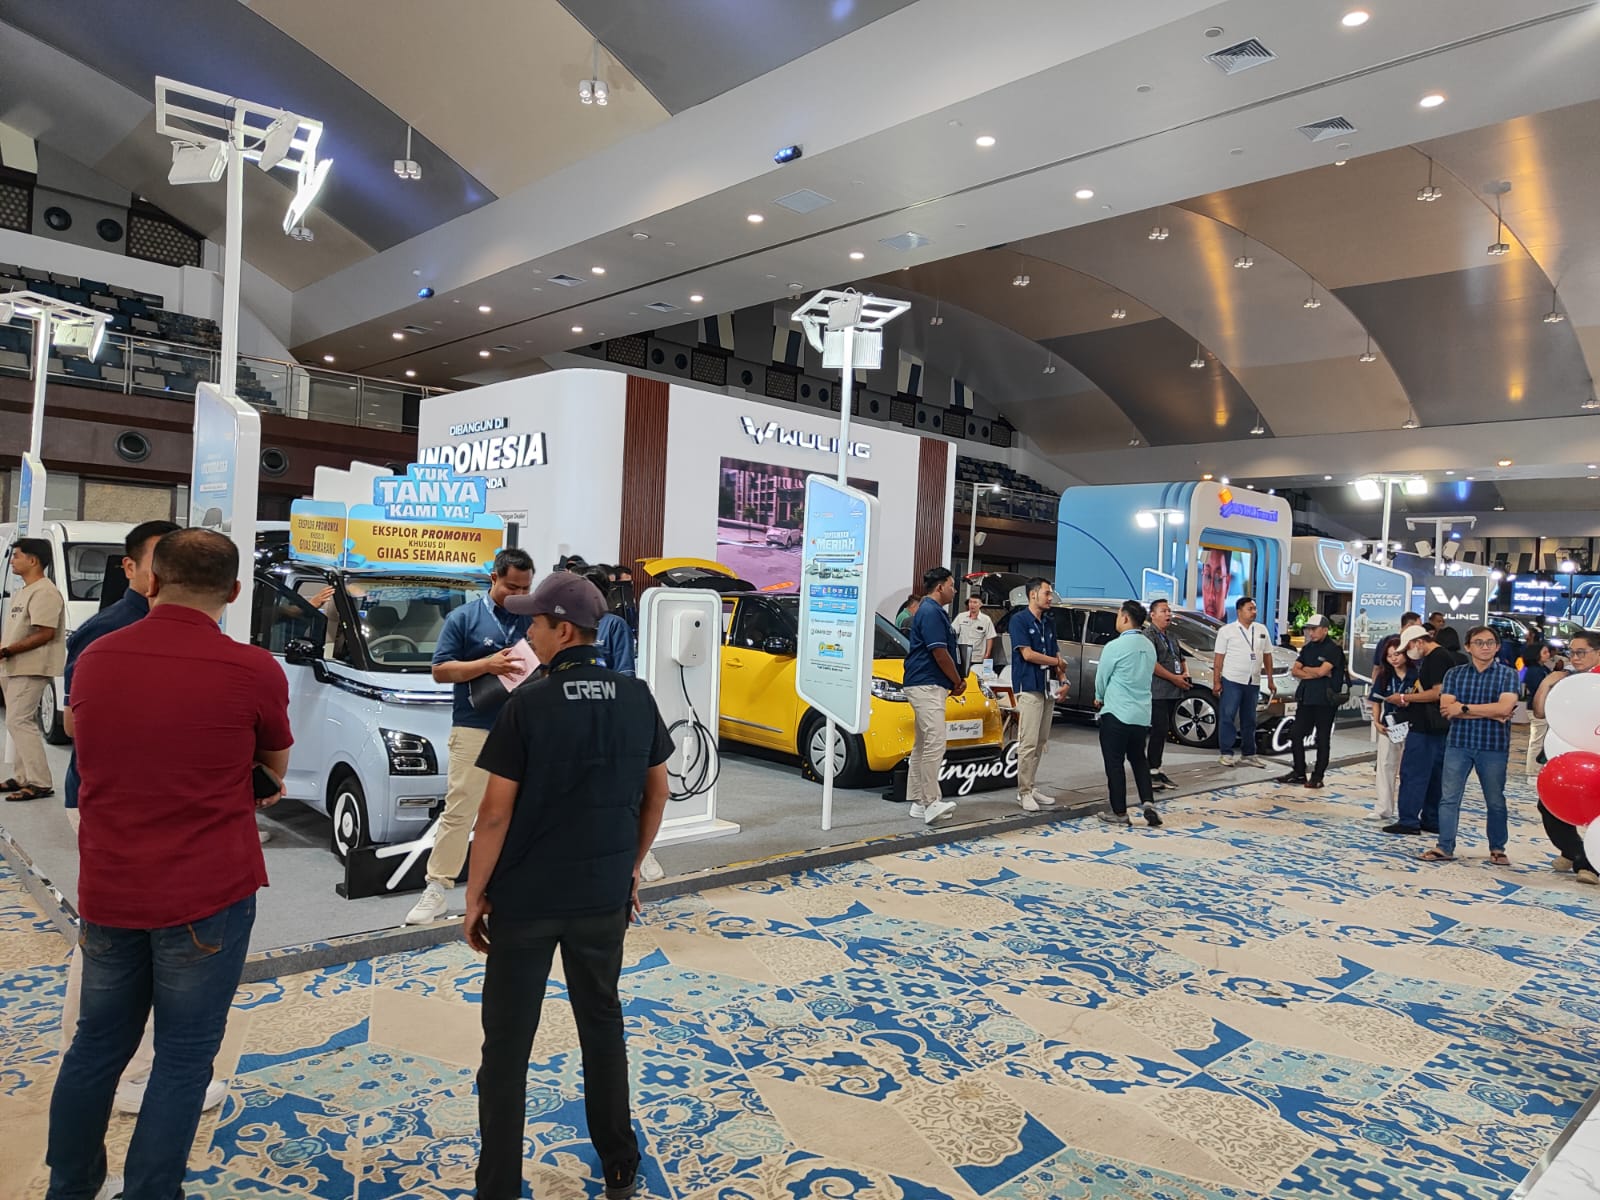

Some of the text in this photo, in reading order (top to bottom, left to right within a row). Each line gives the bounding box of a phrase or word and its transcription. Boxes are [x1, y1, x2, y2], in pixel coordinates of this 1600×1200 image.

[449, 417, 506, 436] DIBANGUN DI
[413, 467, 450, 481] YUK
[379, 481, 480, 504] TANYA
[389, 503, 471, 519] KAMI YA!
[372, 525, 482, 543] EKSPLOR PROMONYA
[408, 539, 446, 550] KHUSUS DI
[376, 546, 477, 564] GIIAS SEMARANG
[1360, 598, 1402, 607] DARION
[563, 681, 616, 700] CREW
